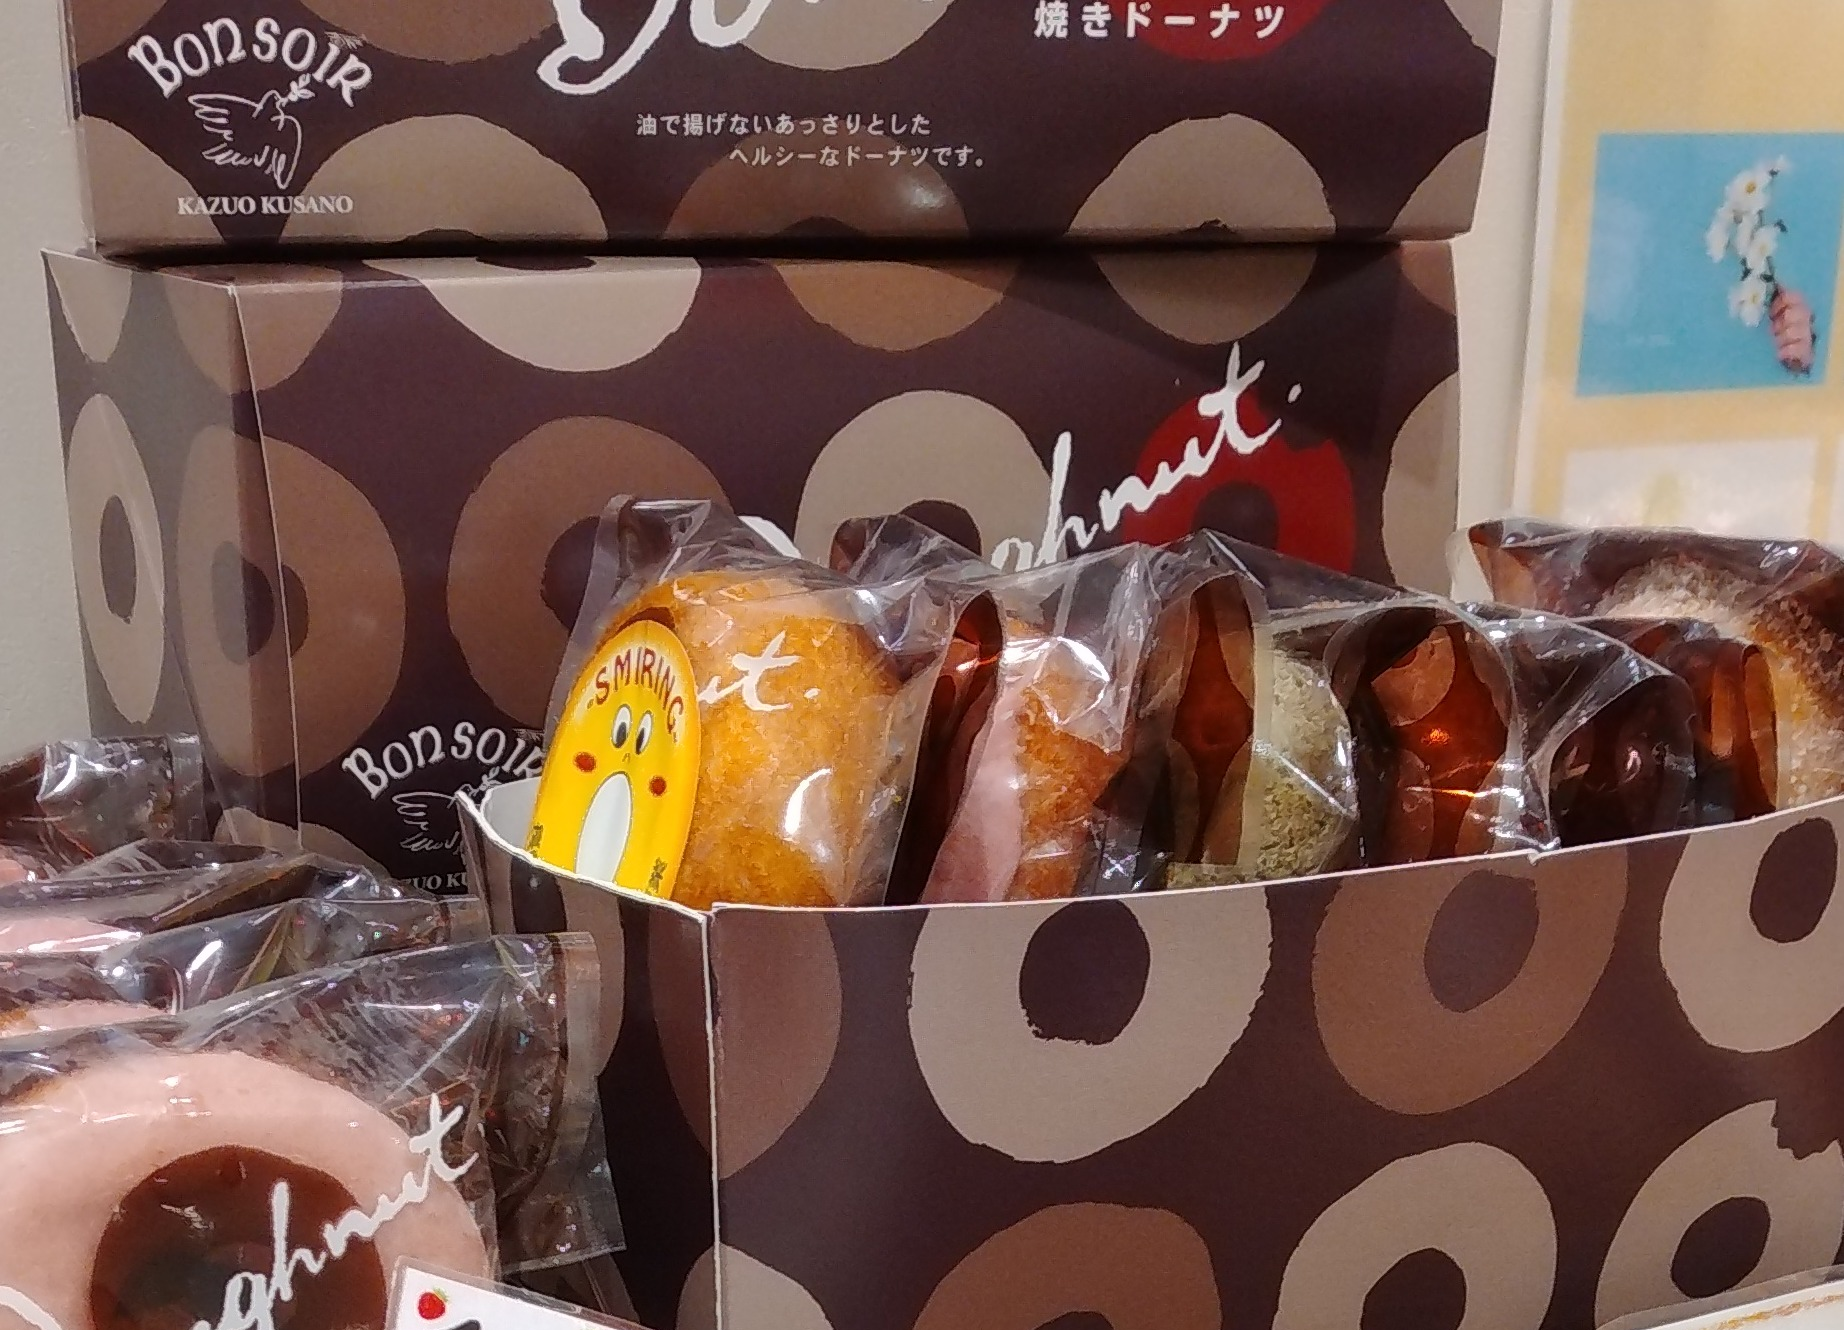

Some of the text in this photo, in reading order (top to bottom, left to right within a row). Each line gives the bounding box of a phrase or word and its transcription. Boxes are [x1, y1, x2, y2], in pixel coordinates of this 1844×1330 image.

[1034, 1, 1285, 39] 焼きドーナツ
[636, 113, 931, 136] 油で揚げないあっさりとした
[729, 146, 984, 168] ヘルシーなドーナツです。
[177, 195, 354, 216] KAZUO KUSANO
